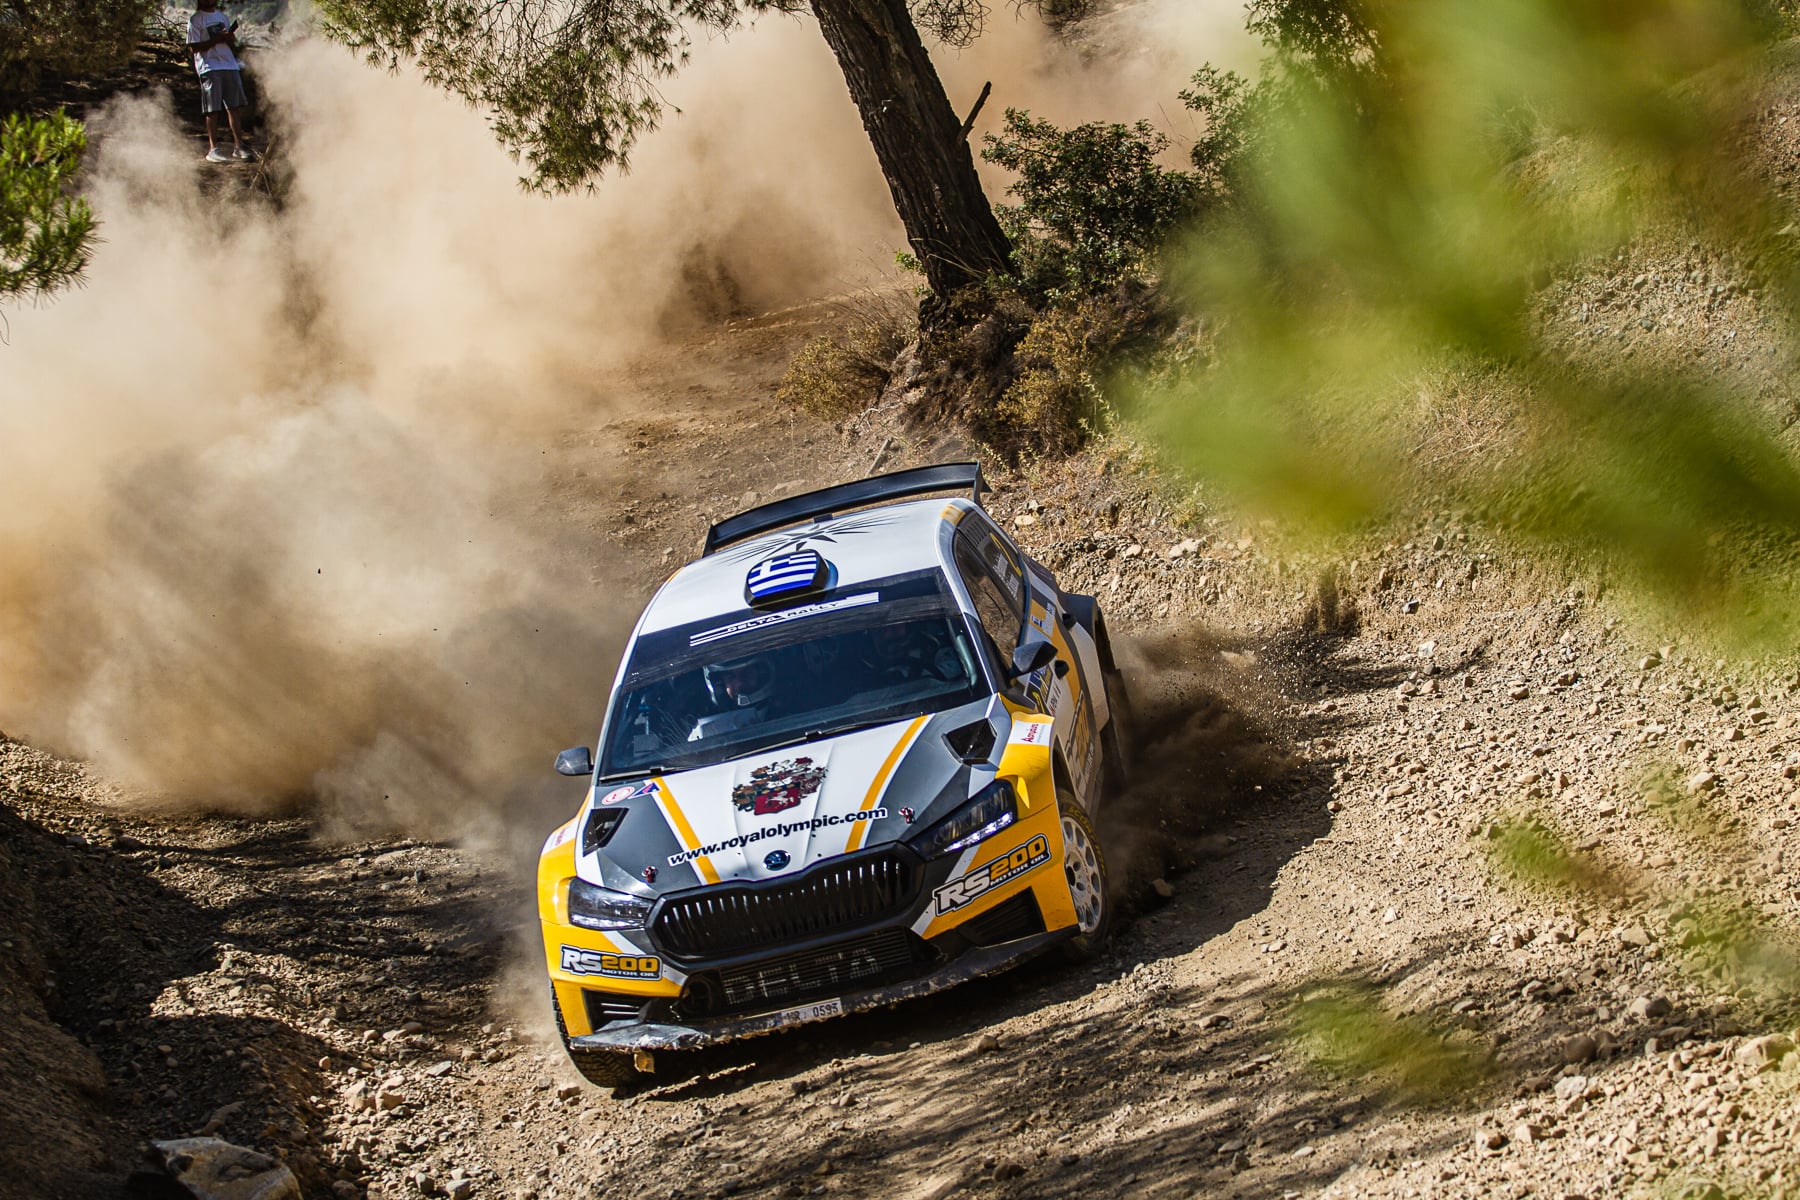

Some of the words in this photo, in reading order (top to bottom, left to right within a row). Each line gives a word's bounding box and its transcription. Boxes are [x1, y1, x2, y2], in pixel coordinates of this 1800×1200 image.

[726, 616, 780, 633] DELTA
[787, 602, 840, 617] RALLY
[670, 808, 886, 866] www.royalolympic.com
[937, 836, 1046, 911] RS200
[990, 863, 1029, 886] MOTOR
[1031, 854, 1046, 865] OIL
[561, 947, 659, 972] RS200
[602, 968, 639, 977] MOTOR
